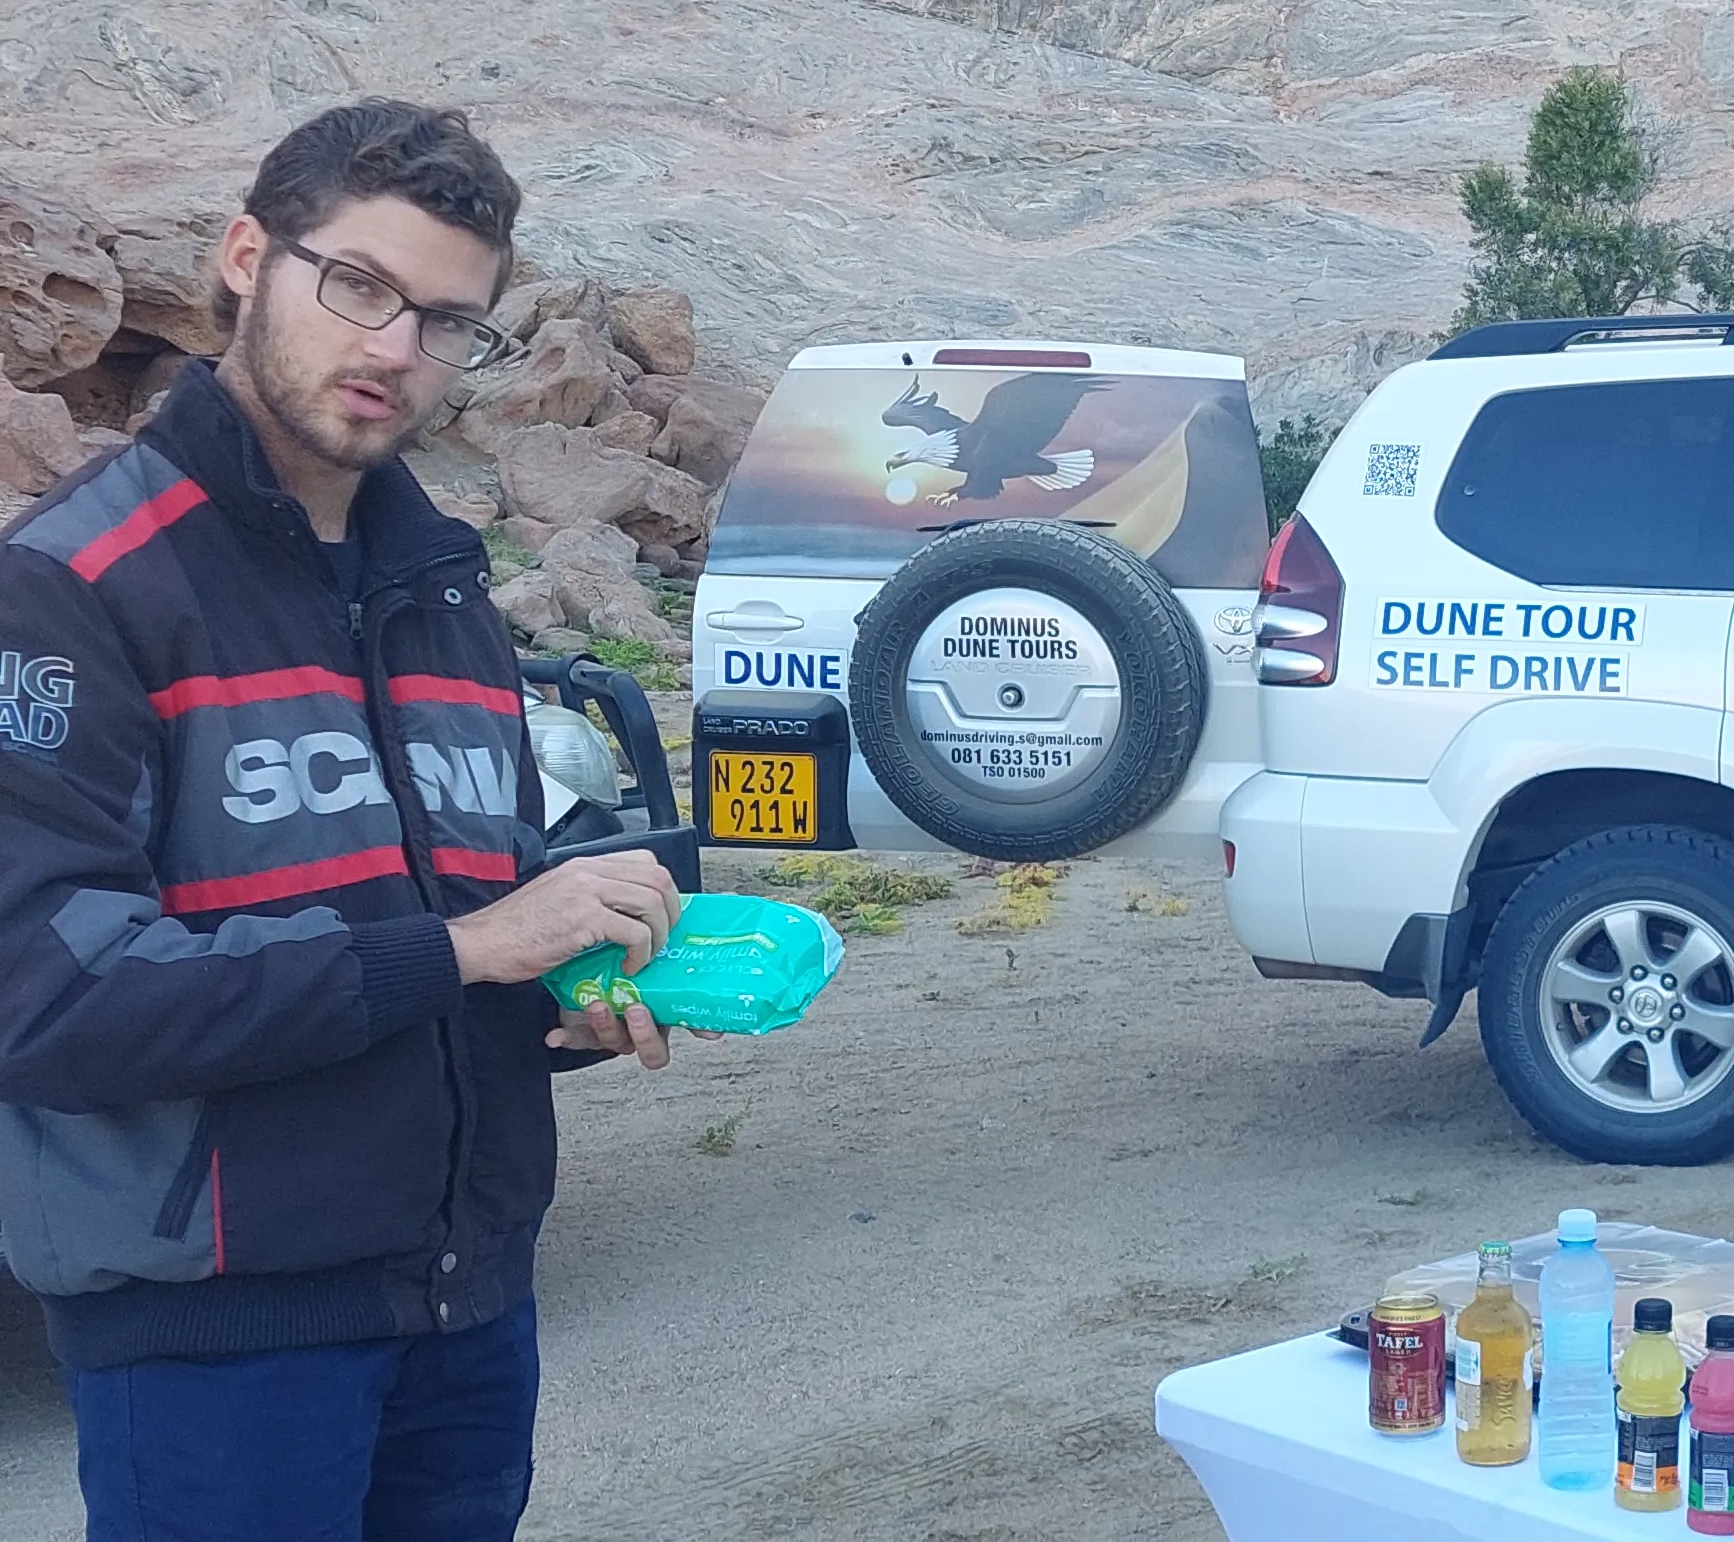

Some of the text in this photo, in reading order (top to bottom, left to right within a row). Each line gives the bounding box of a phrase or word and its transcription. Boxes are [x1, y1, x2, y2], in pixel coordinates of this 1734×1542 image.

[960, 616, 1060, 638] DOMINUS
[1382, 601, 1637, 642] DUNE TOUR
[943, 637, 1078, 660] DUNE TOURS
[724, 650, 841, 689] DUNE
[930, 660, 1092, 677] LAND CRUISER
[1376, 650, 1621, 693] SELF DRIVE
[871, 621, 961, 815] GEOLANDAR
[1091, 629, 1150, 803] YOKOHAMA
[733, 719, 809, 736] PRADO
[920, 729, 1103, 747] dominusdriving.s@gmail.com
[951, 747, 1072, 767] 081 633 5151
[714, 758, 795, 795] N 232
[1008, 766, 1046, 779] 01500
[730, 798, 808, 835] 911 W
[655, 945, 704, 960] wipe
[671, 1004, 758, 1024] family wipes
[1376, 1333, 1423, 1349] TAFEL
